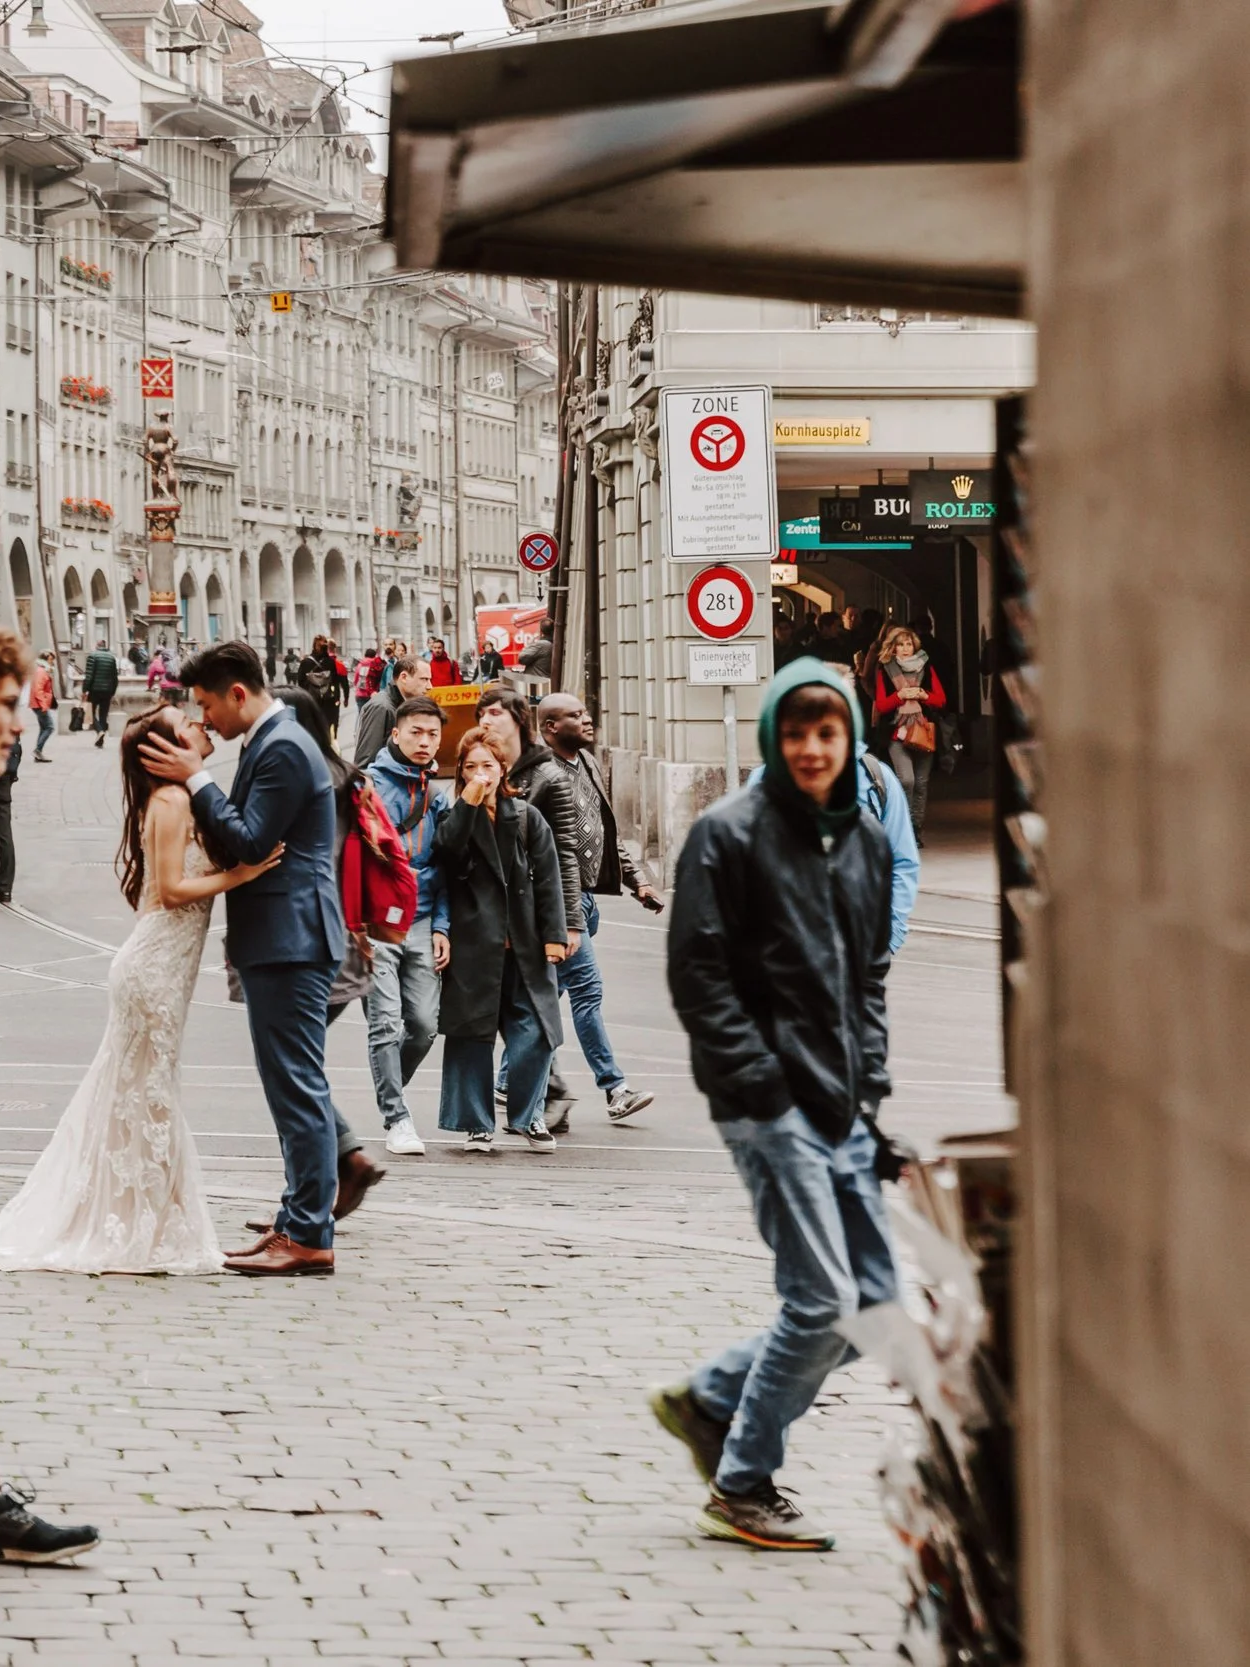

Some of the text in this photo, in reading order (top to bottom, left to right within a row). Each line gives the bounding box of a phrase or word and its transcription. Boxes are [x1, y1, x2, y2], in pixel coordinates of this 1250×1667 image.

[691, 396, 740, 414] ZONE
[774, 422, 862, 440] Kornhausplatz
[925, 502, 998, 518] ROLEX
[693, 650, 751, 662] Linienverkehr
[703, 667, 742, 680] gestattet
